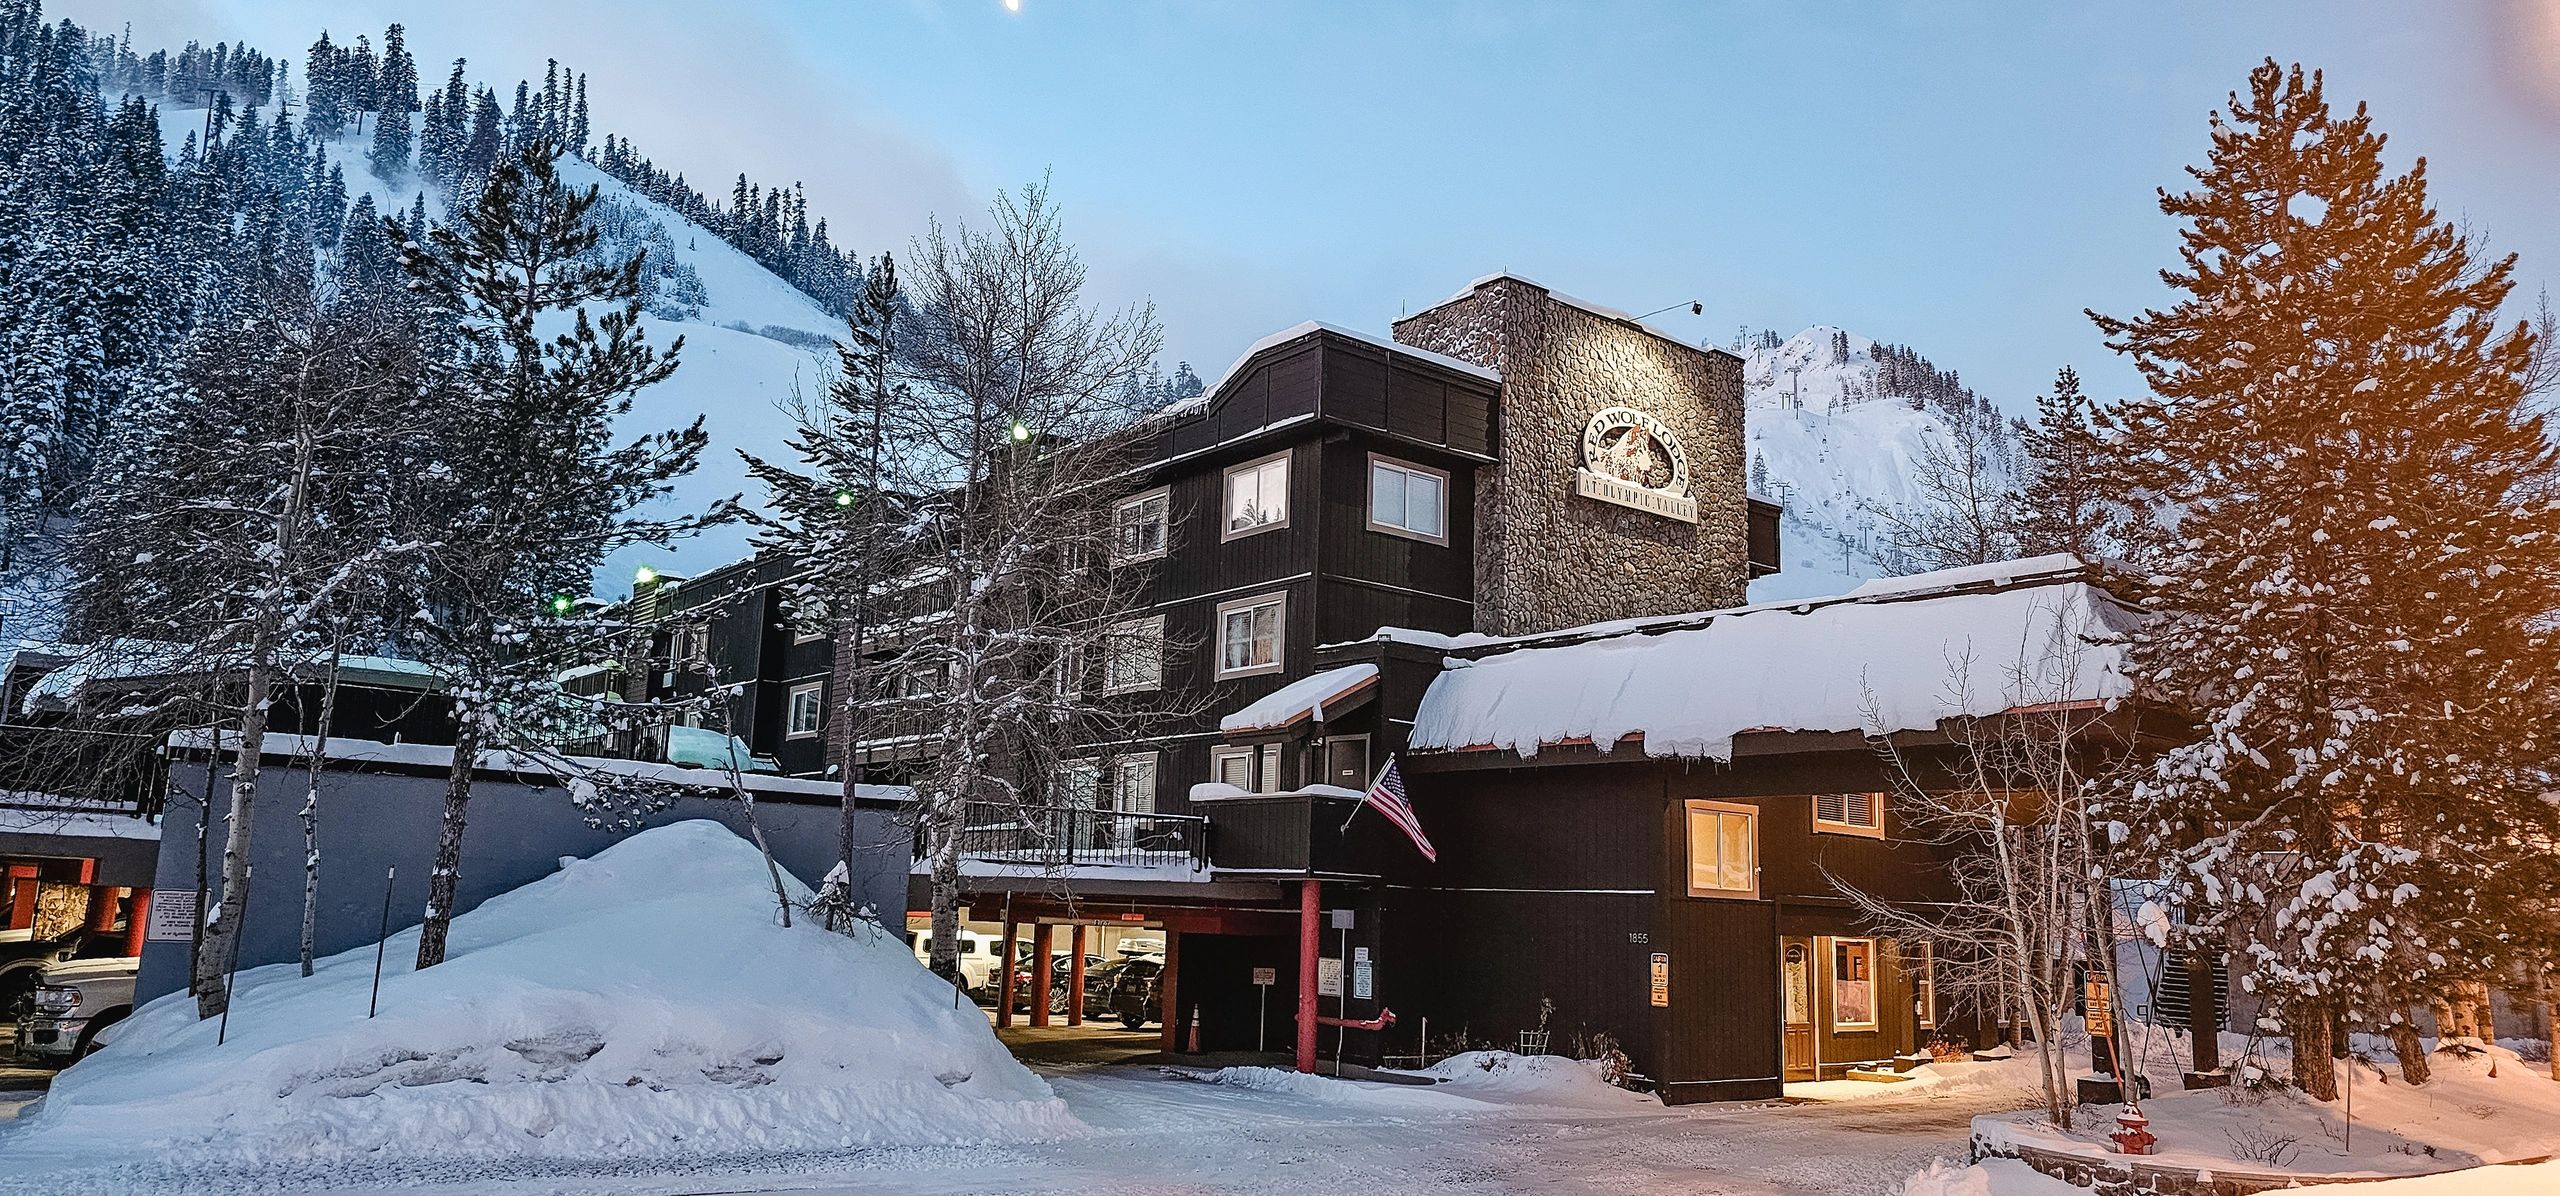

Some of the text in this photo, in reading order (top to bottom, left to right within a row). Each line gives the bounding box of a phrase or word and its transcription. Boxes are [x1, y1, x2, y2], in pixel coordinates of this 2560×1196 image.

[1587, 411, 1686, 489] RED WOLF LODGE
[1584, 479, 1694, 519] AT OLYMPIC VALLEY
[1629, 933, 1648, 944] 1855
